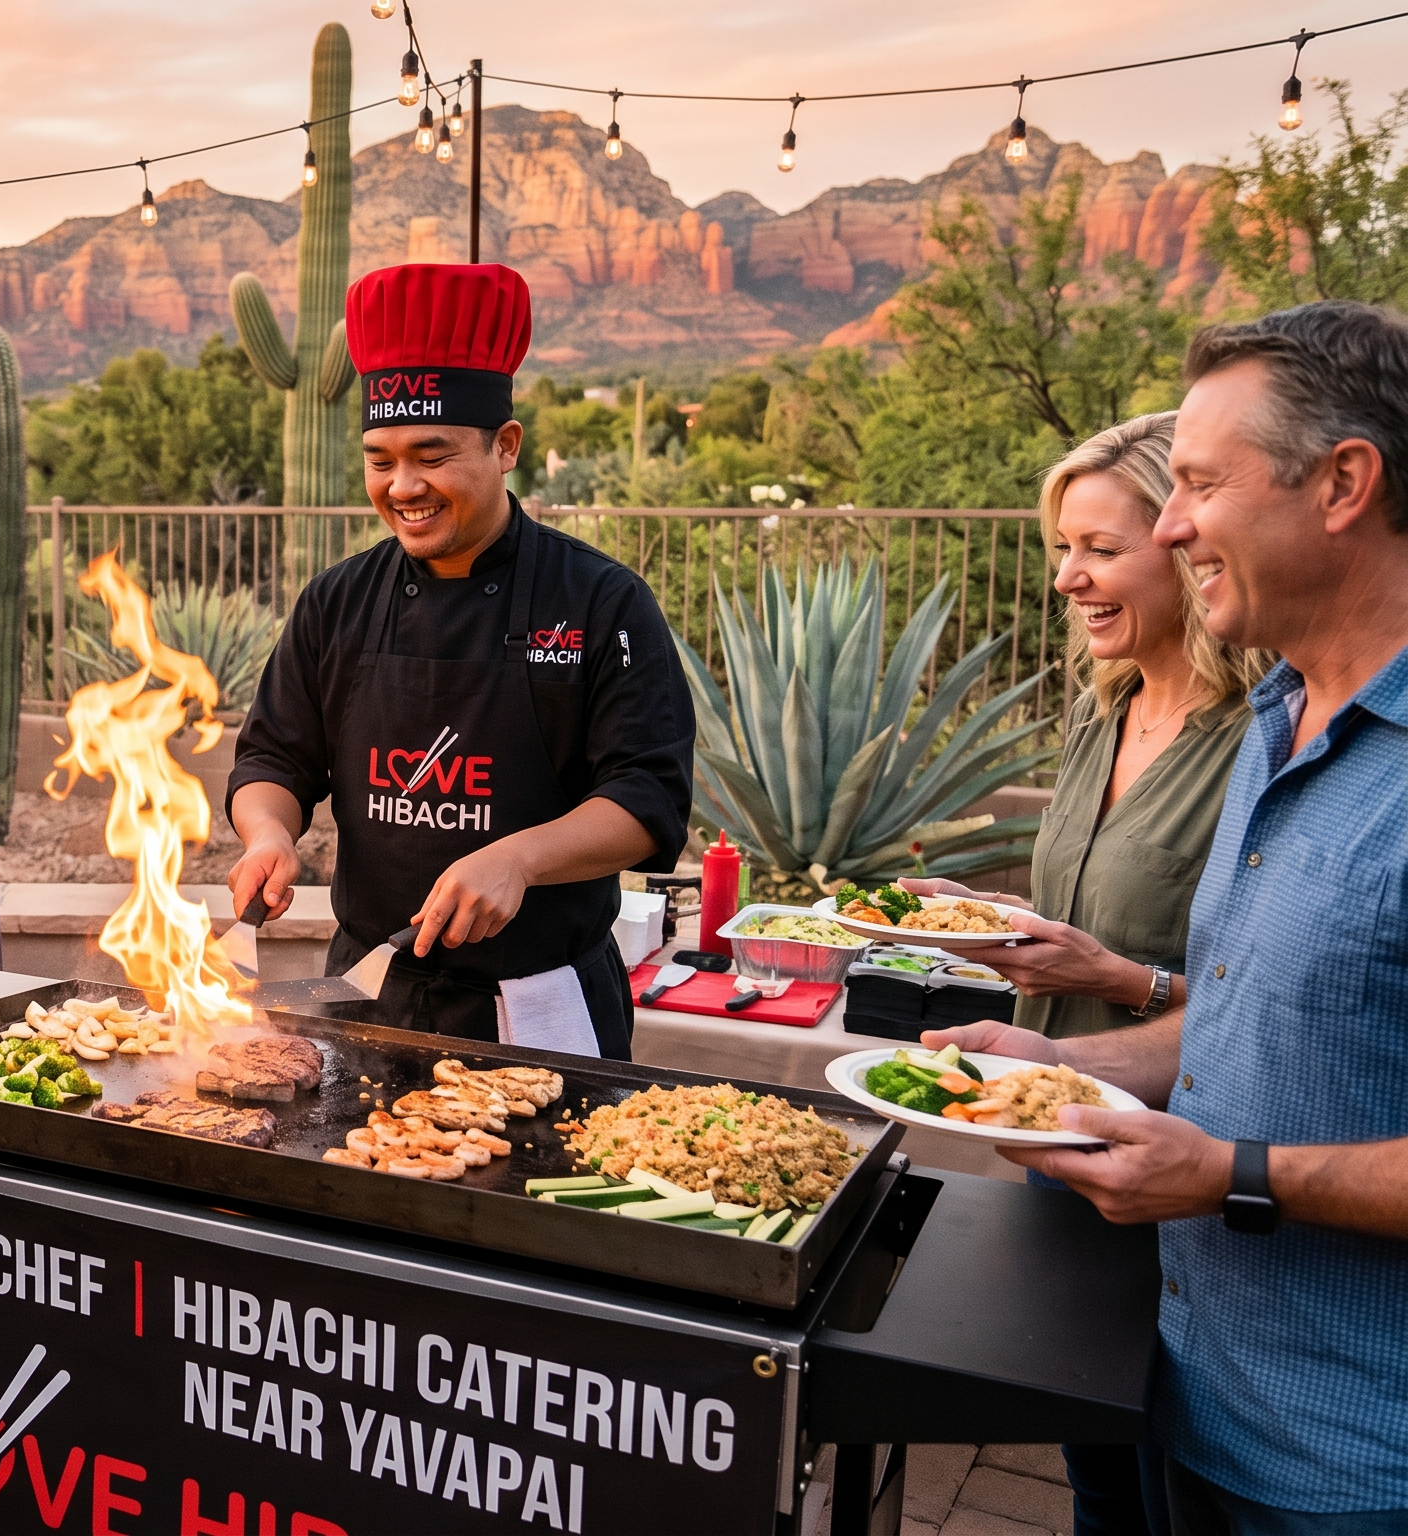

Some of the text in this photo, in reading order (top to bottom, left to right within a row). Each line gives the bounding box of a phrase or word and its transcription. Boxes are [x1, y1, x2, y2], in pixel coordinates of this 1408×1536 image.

[369, 372, 441, 401] LOVE
[369, 400, 442, 421] HIBACHI
[368, 747, 493, 797] LOVE
[368, 793, 491, 831] HIBACHI
[174, 1275, 396, 1392] HIBACHI
[417, 1333, 735, 1472] CATERING
[184, 1360, 324, 1461] NEAR
[340, 1401, 584, 1534] YAVAPAI
